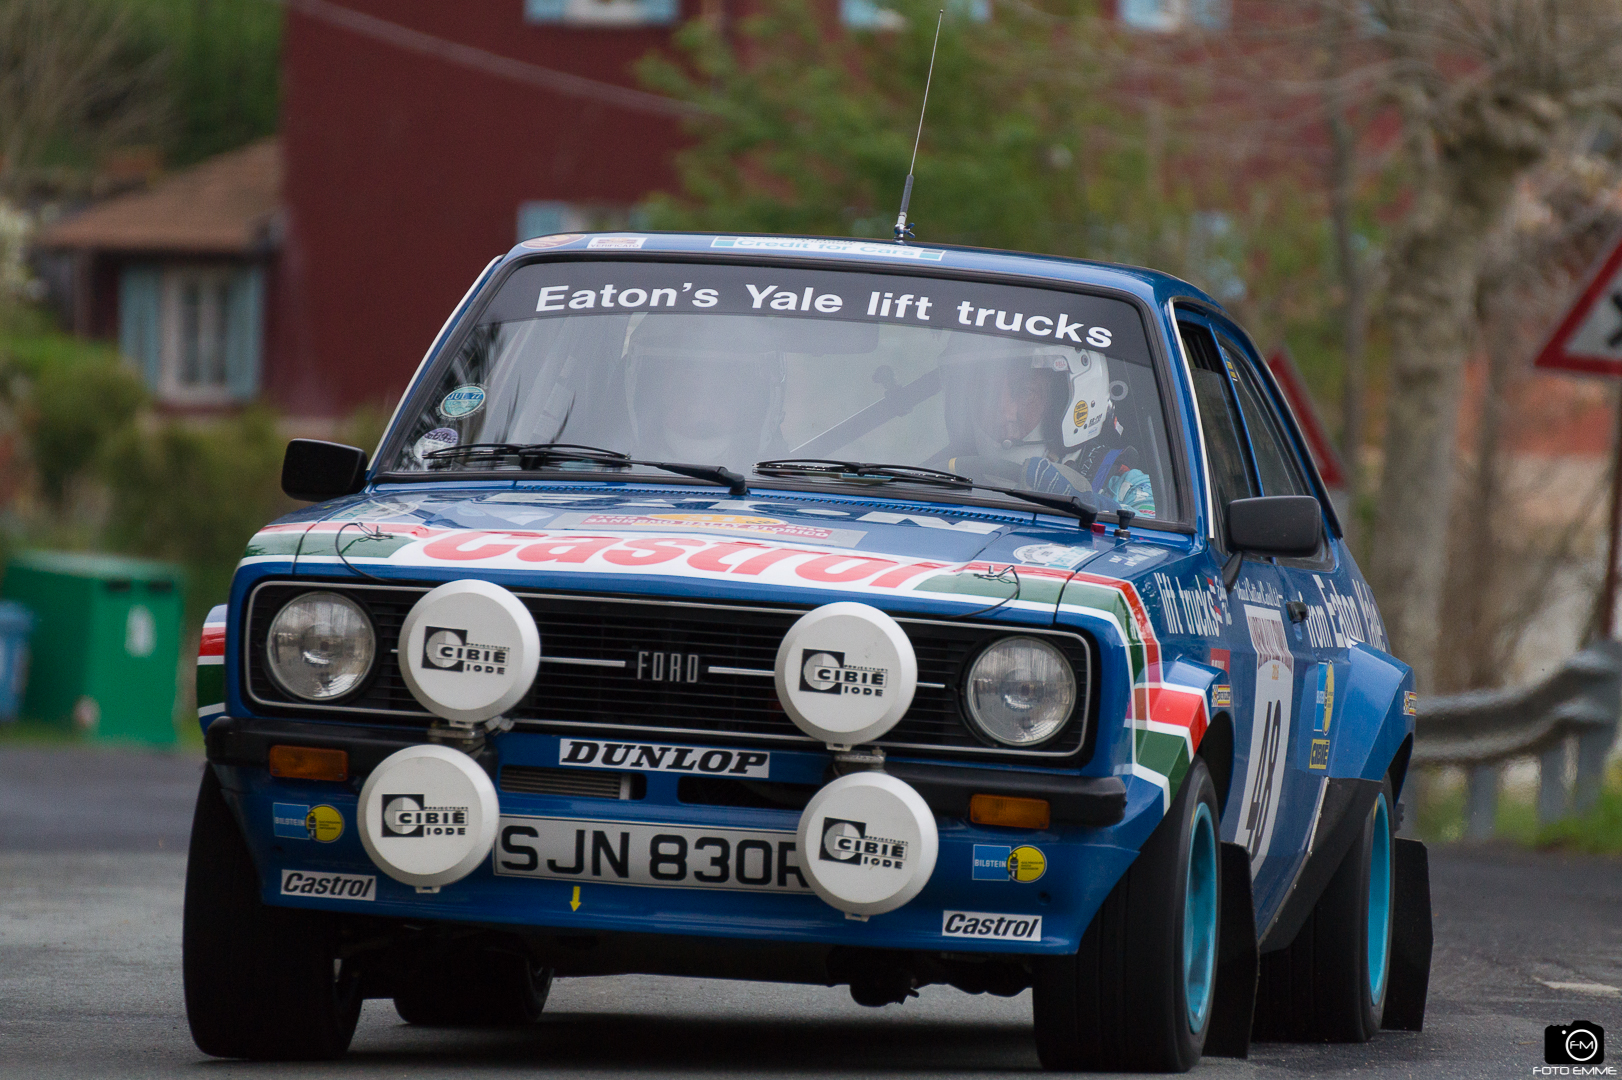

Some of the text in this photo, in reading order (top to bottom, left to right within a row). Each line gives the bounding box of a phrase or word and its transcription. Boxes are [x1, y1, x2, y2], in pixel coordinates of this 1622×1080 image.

[737, 239, 809, 249] Credit
[818, 243, 853, 253] for
[859, 246, 915, 256] Cars
[535, 282, 1113, 348] Eaton's Yale lift trucks
[584, 518, 677, 526] SANREMO
[679, 520, 744, 530] RALLY
[747, 524, 829, 538] STORICO
[1175, 573, 1220, 637] trucks
[466, 664, 505, 675] IODE
[636, 650, 699, 684] FORD
[844, 686, 883, 697] IODE
[561, 741, 768, 776] DUNLOP
[274, 817, 305, 826] BILSTEIN
[426, 827, 466, 835] IODE
[502, 826, 630, 879] SJN
[863, 856, 904, 870] IODE
[974, 859, 1006, 868] BILSTEIN
[283, 872, 375, 898] Castrol
[944, 912, 1042, 939] Castrol
